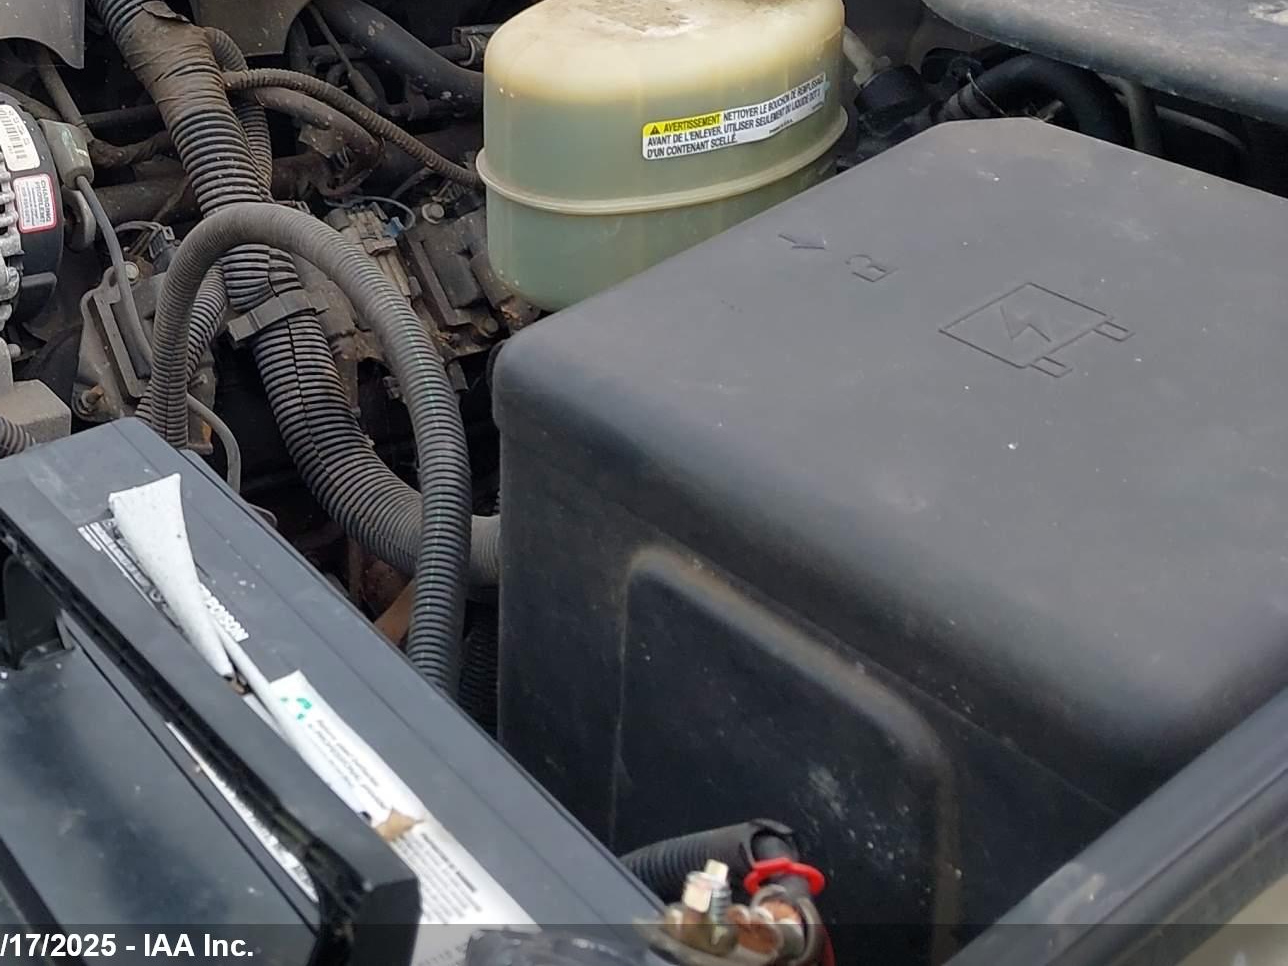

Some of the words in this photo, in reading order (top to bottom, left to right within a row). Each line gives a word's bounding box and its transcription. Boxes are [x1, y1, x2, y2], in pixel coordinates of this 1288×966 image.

[647, 135, 672, 147] AVANT
[672, 133, 683, 143] DE
[724, 118, 755, 134] UTILISER
[755, 107, 785, 128] SEULEMENT
[663, 113, 721, 133] AVERTISSEMENT
[723, 106, 759, 121] NETTOYER
[759, 103, 768, 115] LE
[768, 94, 790, 112] BOUCHON
[647, 147, 665, 159] D'UN
[666, 140, 709, 156] CONTENANT
[40, 180, 52, 223] CHARGING
